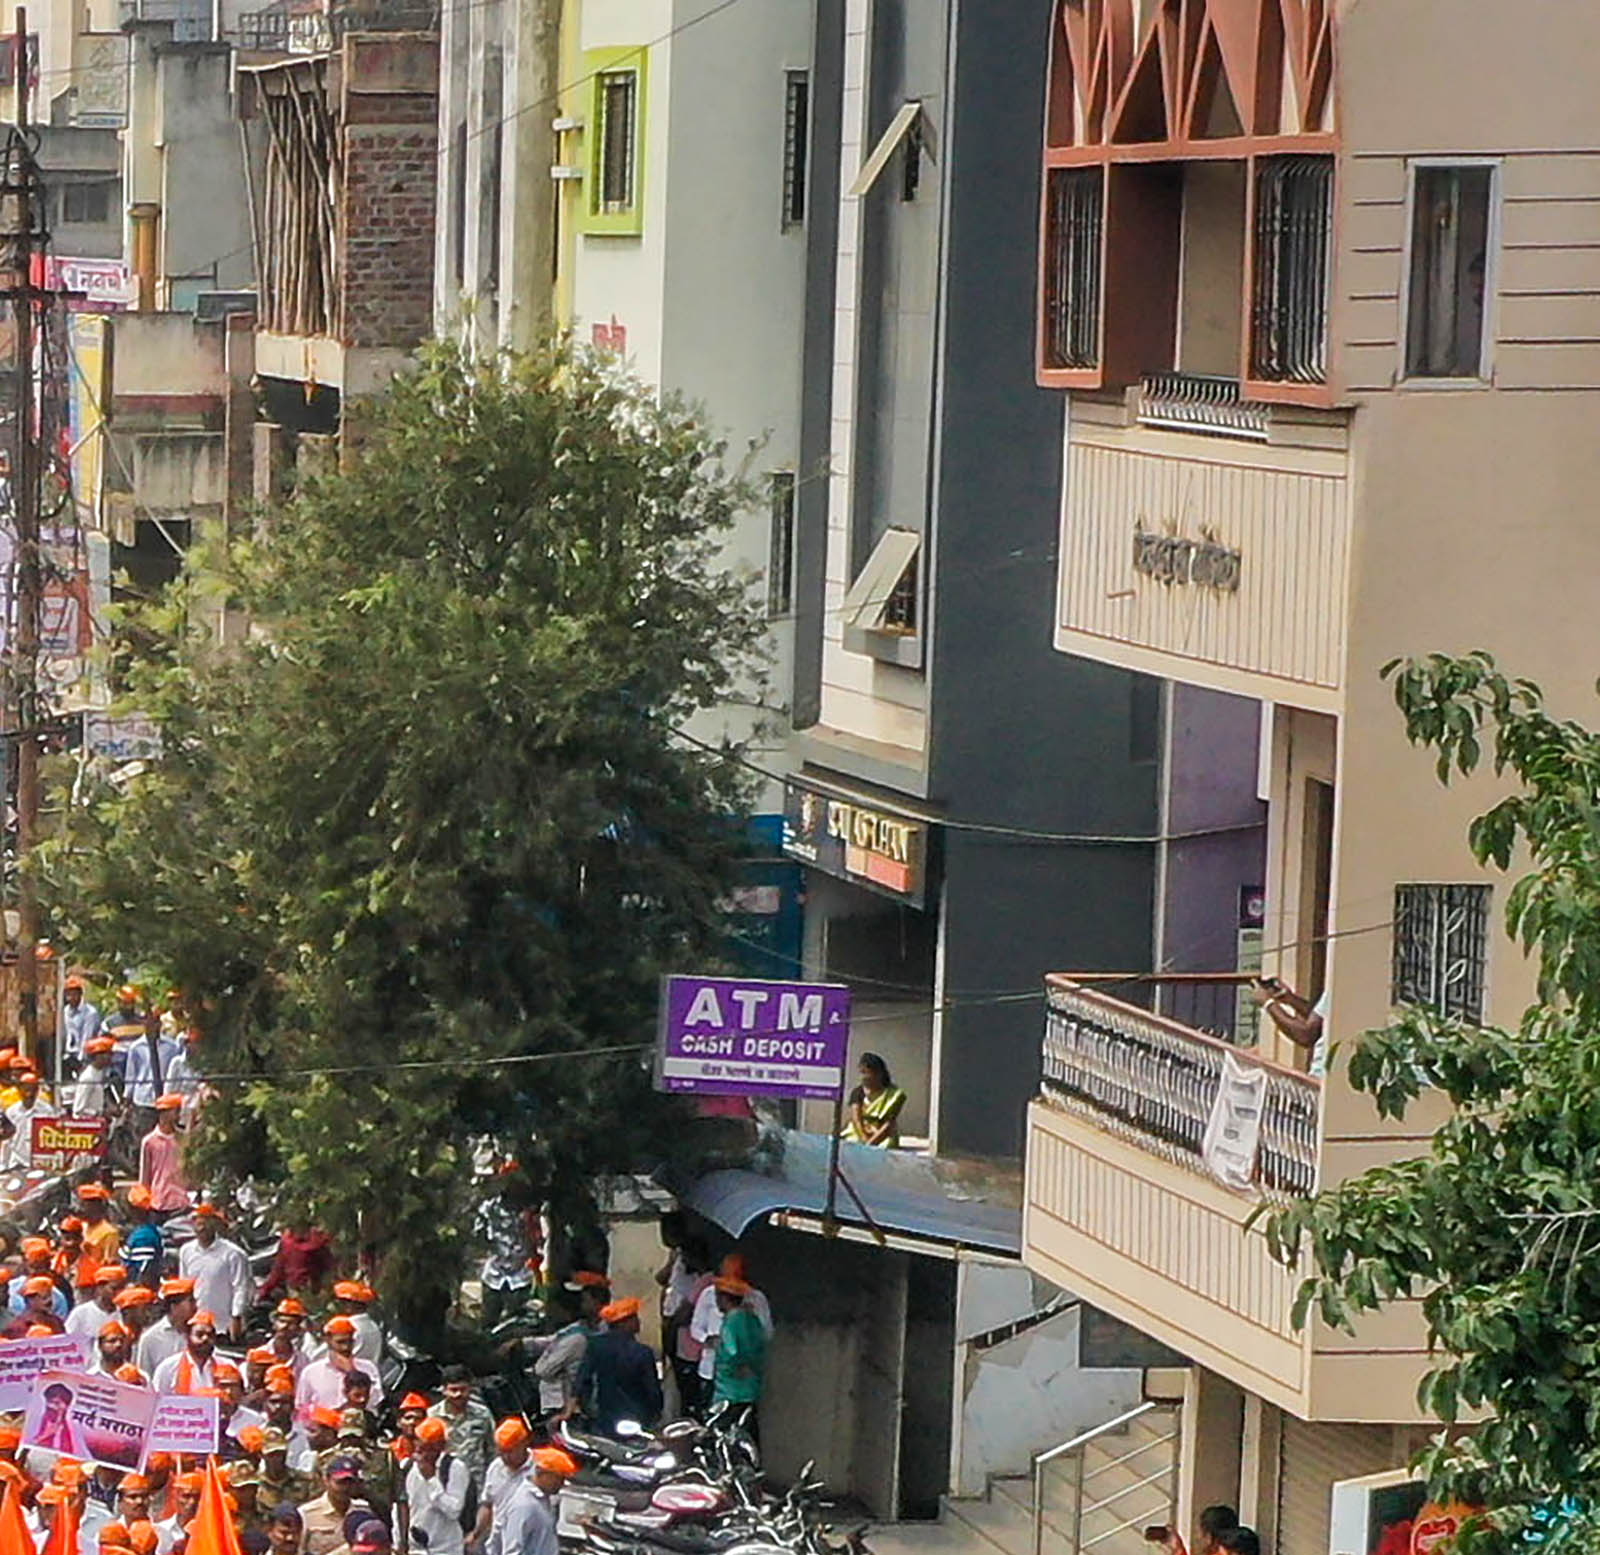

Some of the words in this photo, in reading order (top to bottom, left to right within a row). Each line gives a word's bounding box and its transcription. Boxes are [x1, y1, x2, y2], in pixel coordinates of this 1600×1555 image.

[683, 986, 824, 1033] ATM
[680, 1033, 734, 1055] CASH
[743, 1037, 827, 1061] DEPOSIT
[71, 1408, 97, 1429] मर्द
[99, 1416, 145, 1439] मराठा
